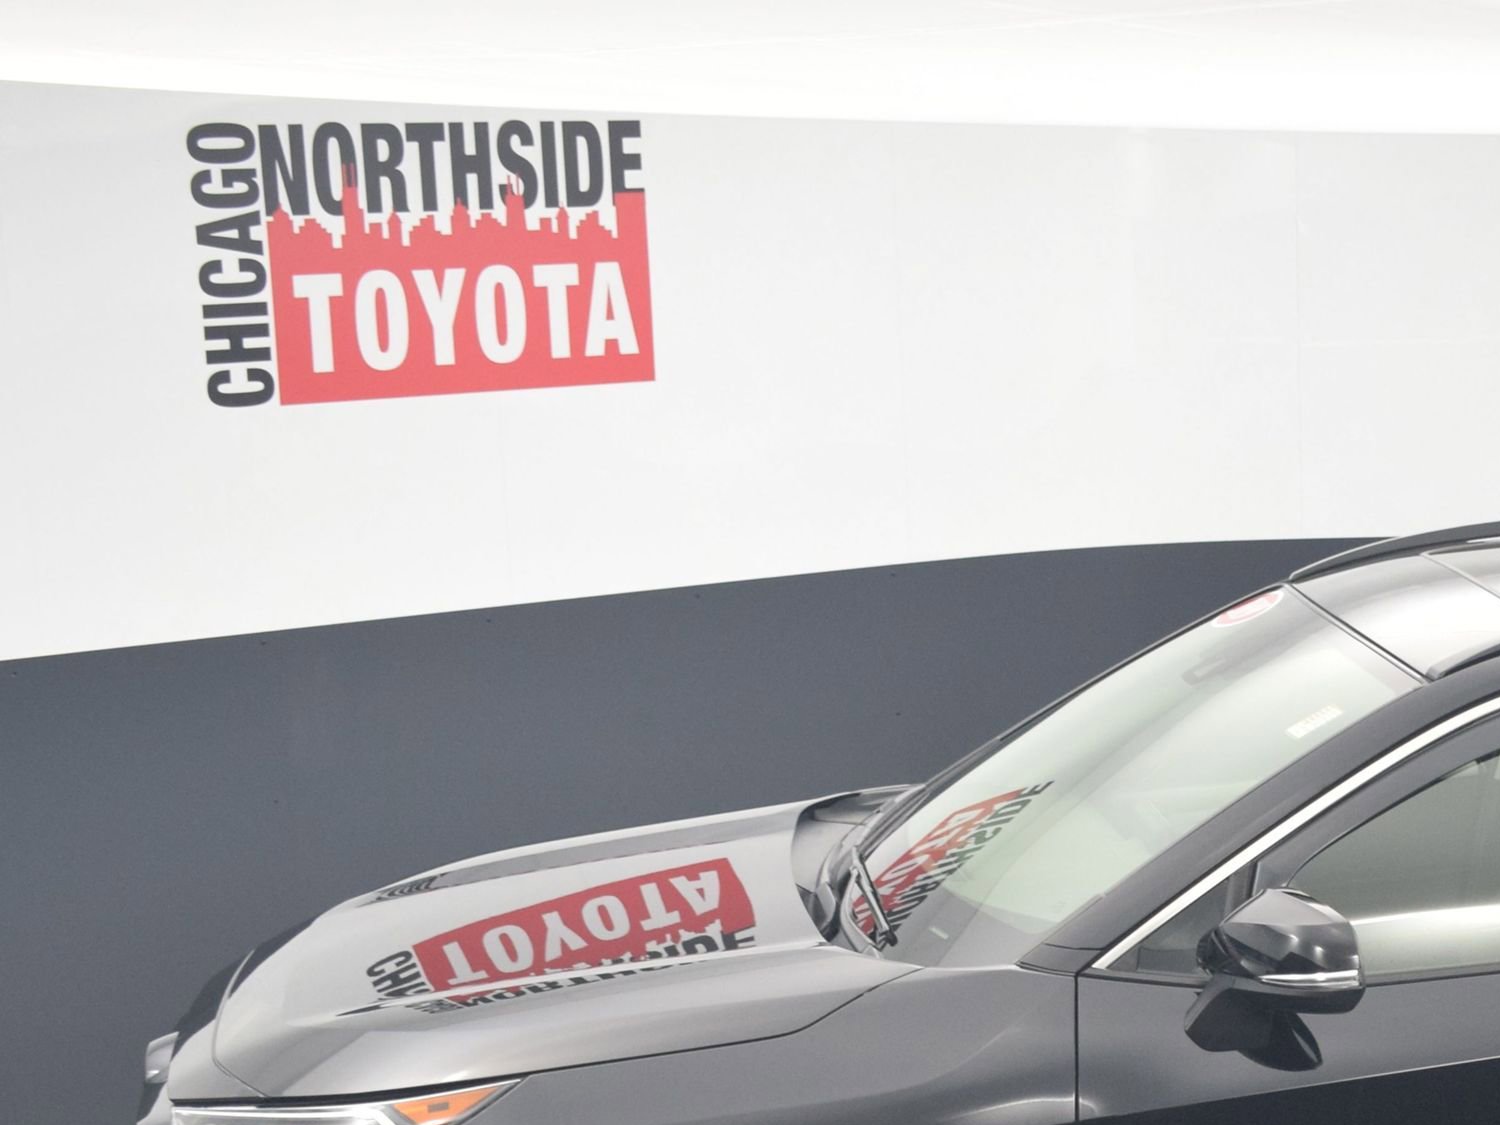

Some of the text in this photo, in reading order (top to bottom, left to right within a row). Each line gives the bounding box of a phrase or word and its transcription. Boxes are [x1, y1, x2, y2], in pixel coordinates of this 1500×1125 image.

[258, 120, 645, 217] NORTHSIDE
[186, 122, 275, 408] CHICAGO
[293, 262, 639, 373] TOYOTA
